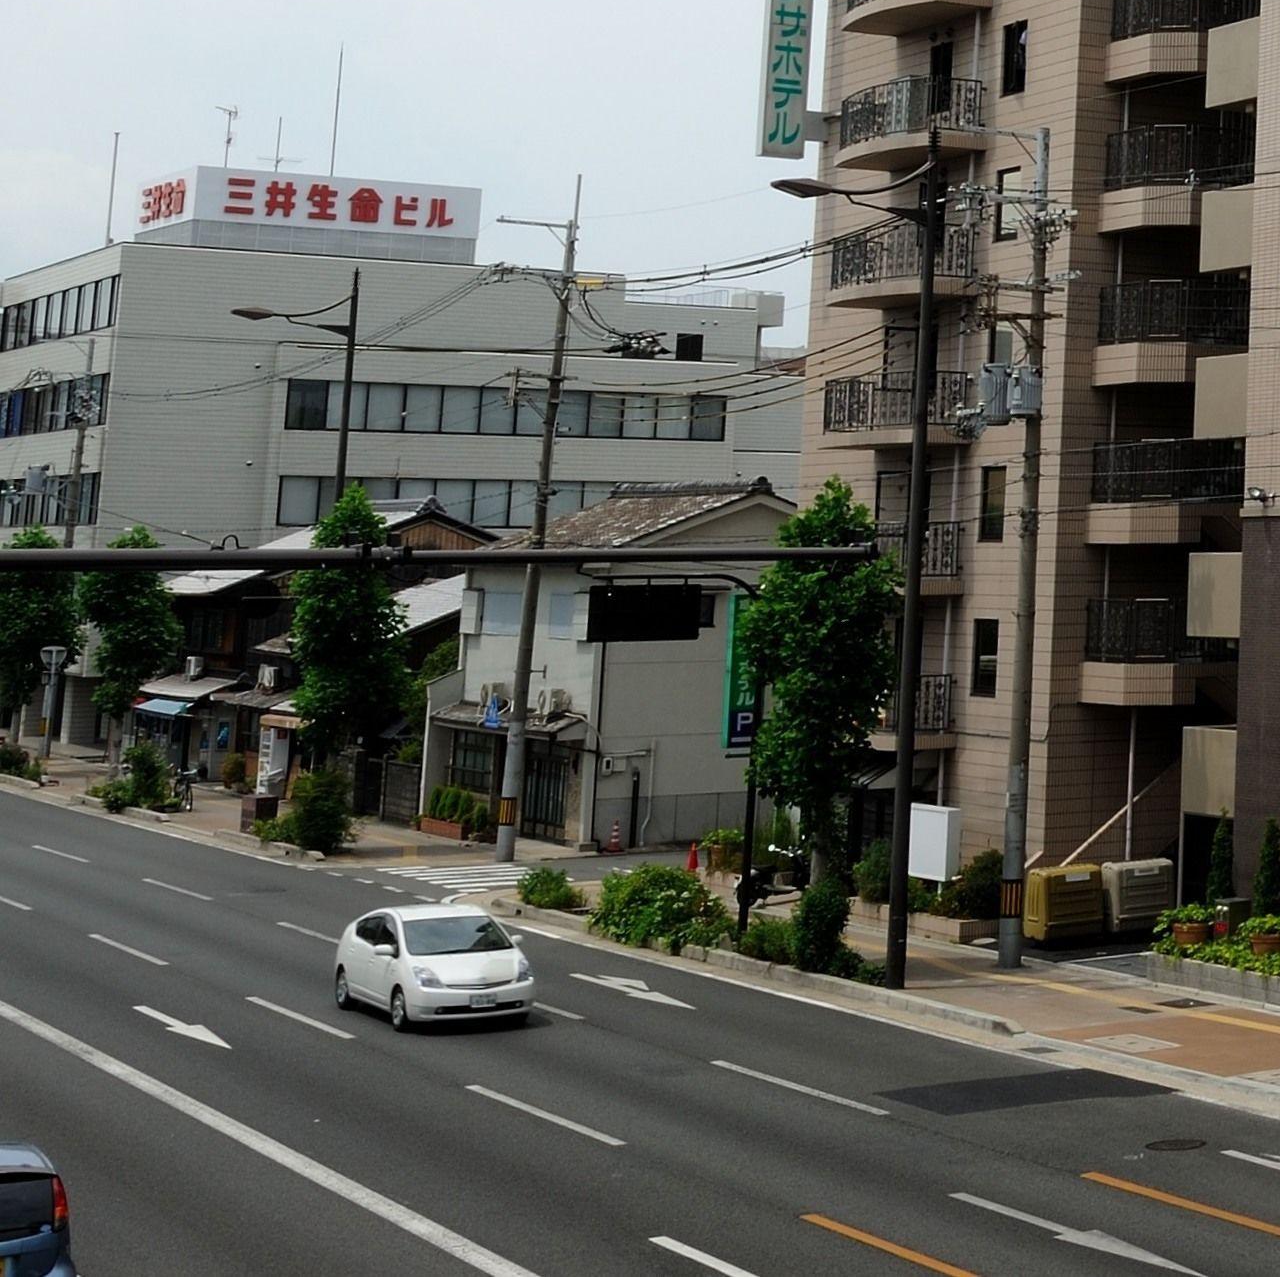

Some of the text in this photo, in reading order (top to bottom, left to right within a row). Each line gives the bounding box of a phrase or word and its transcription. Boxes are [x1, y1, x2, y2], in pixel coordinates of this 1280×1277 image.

[223, 176, 455, 230] 三井生命ビル
